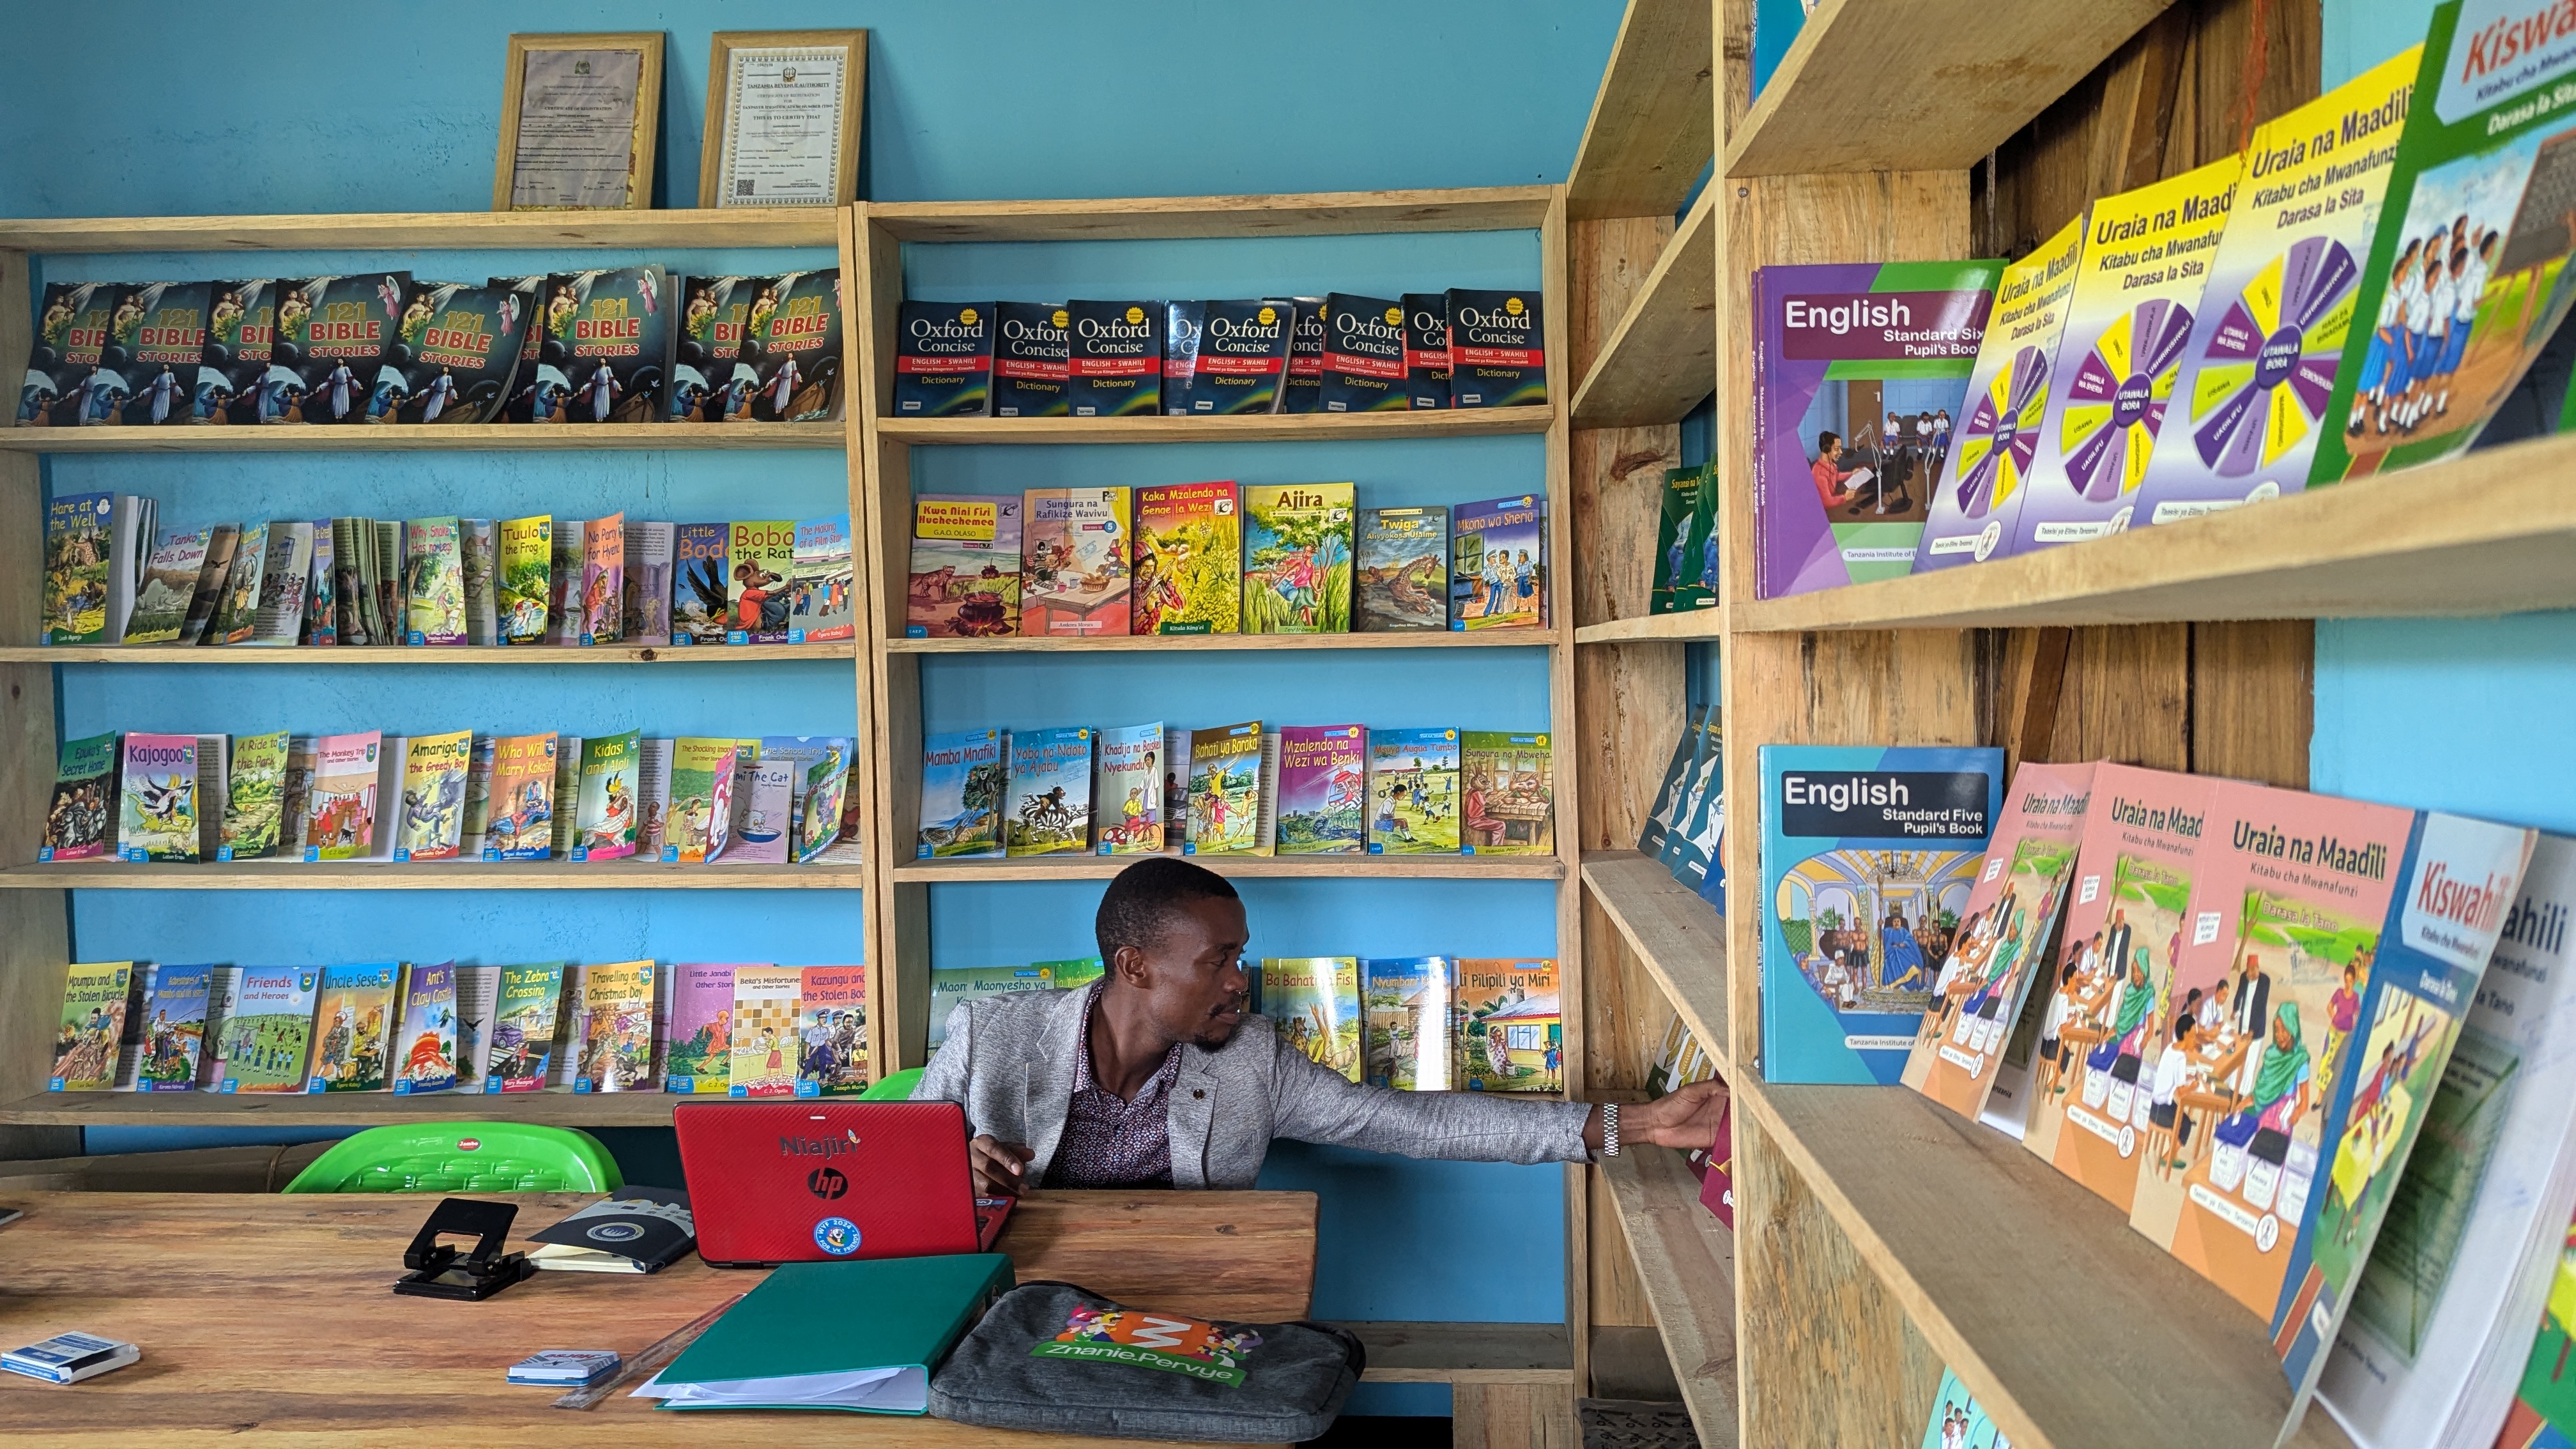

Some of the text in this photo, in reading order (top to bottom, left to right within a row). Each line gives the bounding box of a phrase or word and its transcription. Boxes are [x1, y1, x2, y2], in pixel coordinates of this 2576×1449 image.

[2251, 141, 2305, 179] Uraia
[2312, 132, 2334, 157] na
[2253, 183, 2295, 210] Kitabu
[2299, 176, 2320, 195] cha
[2277, 188, 2364, 228] Darasa la Sita
[324, 302, 367, 323] 121
[591, 298, 627, 319] 121
[1459, 307, 1531, 330] Oxford
[1786, 299, 1910, 334] English
[309, 320, 381, 341] BIBLE
[575, 317, 640, 340] BIBLE
[910, 319, 983, 338] Oxford
[1884, 329, 1984, 341] Standard Six
[1469, 328, 1525, 344] Concise
[309, 344, 380, 358] STORIES
[574, 343, 640, 357] STORIES
[917, 339, 975, 353] Concise
[1465, 348, 1494, 356] ENGLISH
[1905, 344, 1947, 356] Pupil's
[922, 375, 965, 385] Dictionary
[1476, 369, 1521, 378] Dictionary
[1142, 491, 1165, 502] Kaka
[1170, 488, 1213, 501] Mzalendo
[1278, 491, 1323, 510] Ajira
[51, 500, 92, 514] Hare at
[923, 505, 947, 515] Kwa
[974, 507, 991, 516] Fisi
[1046, 500, 1084, 510] Sungura
[1176, 503, 1184, 514] la
[1188, 502, 1212, 512] Wezi
[918, 515, 995, 526] Huchechemea
[1036, 509, 1108, 519] Rafikize Wavivu
[50, 513, 97, 530] the Well
[1381, 519, 1420, 532] Twiga
[1457, 512, 1534, 532] Mkono wa Sheria
[503, 526, 539, 540] Tuulo
[588, 526, 617, 543] No Party
[681, 526, 716, 537] Little
[735, 525, 795, 548] Bobo
[170, 534, 197, 545] Tanko
[505, 542, 539, 555] the Frog
[588, 548, 600, 560] for
[735, 547, 795, 559] the Rat
[151, 548, 203, 564] Falls Down
[356, 748, 366, 757] Trip
[411, 742, 457, 758] Amariga
[1284, 740, 1349, 753] Mzalendo na
[130, 745, 183, 766] Kajogoo
[926, 744, 997, 766] Mamba Mnafiki
[1284, 753, 1360, 767] Wezi wa Benki
[1466, 749, 1499, 758] Sungura
[1516, 750, 1550, 759] Mbweha
[410, 758, 466, 773] the Greedy Boy
[1104, 760, 1146, 774] Nyekundu
[748, 770, 789, 783] The Cat
[1786, 778, 1908, 812] English
[1883, 809, 1982, 821] Standard Five
[1904, 823, 1982, 836] Pupil's Book
[2233, 820, 2388, 882] Uraia na Maadili
[2250, 862, 2359, 898] Kitabu cha Mwanafunzi
[2262, 901, 2299, 921] Darasa
[2312, 914, 2338, 933] Tano
[247, 976, 292, 988] Friends
[326, 973, 378, 989] Uncle Sese
[505, 970, 549, 983] The Zebra
[592, 972, 640, 985] Travelling on
[1471, 972, 1549, 990] Pilipili ya Miri
[506, 985, 545, 999] Crossing
[589, 986, 643, 1000] Christmas Day
[974, 980, 1046, 993] Maonyesho ya
[815, 1167, 843, 1200] hp
[817, 1220, 852, 1234] WYF 2024
[820, 1240, 830, 1250] FOR
[1046, 1345, 1233, 1380] Znanie.Pervye
